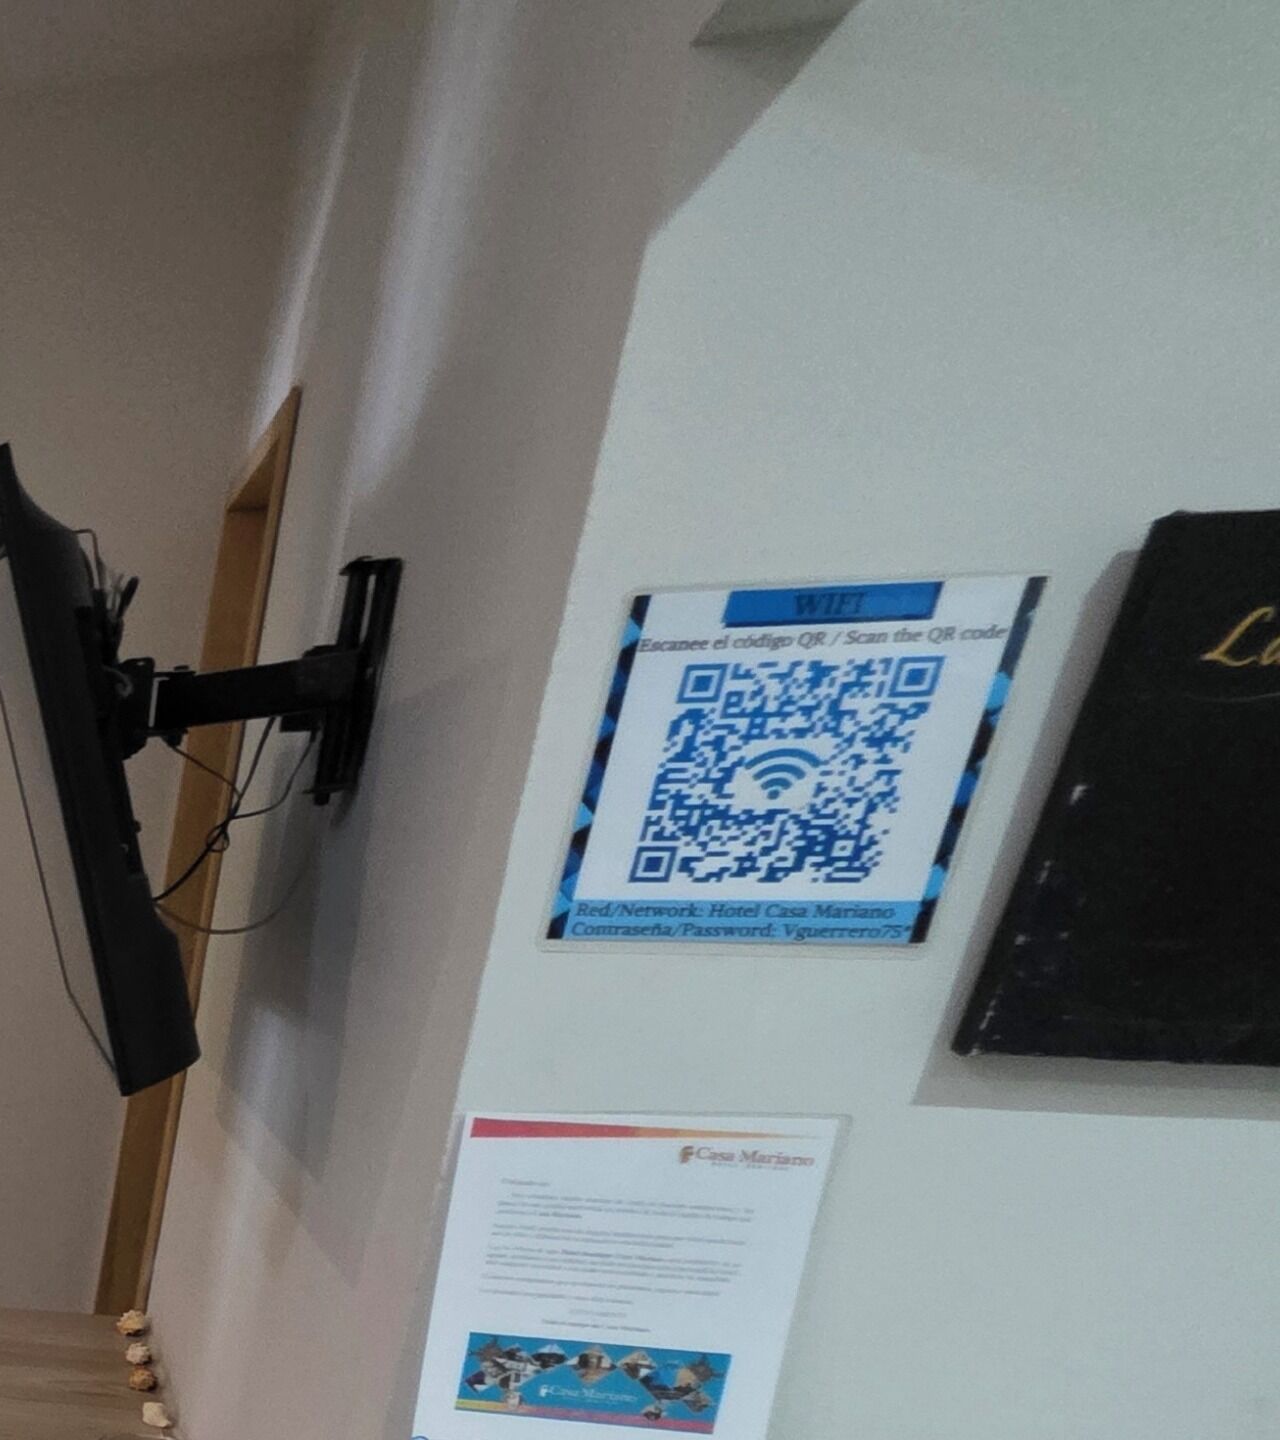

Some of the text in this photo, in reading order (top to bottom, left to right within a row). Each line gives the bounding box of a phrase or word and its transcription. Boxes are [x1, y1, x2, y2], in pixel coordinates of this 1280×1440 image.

[713, 635, 730, 650] el
[797, 631, 827, 649] QR
[829, 631, 842, 647] /
[843, 630, 888, 645] Scan
[893, 627, 923, 643] the
[927, 626, 957, 644] QR
[960, 624, 1009, 641] code
[706, 903, 761, 918] Hotel
[765, 904, 808, 919] Casa
[813, 904, 896, 920] Mariano
[695, 1147, 736, 1162] Casa
[739, 1149, 815, 1167] Mariano
